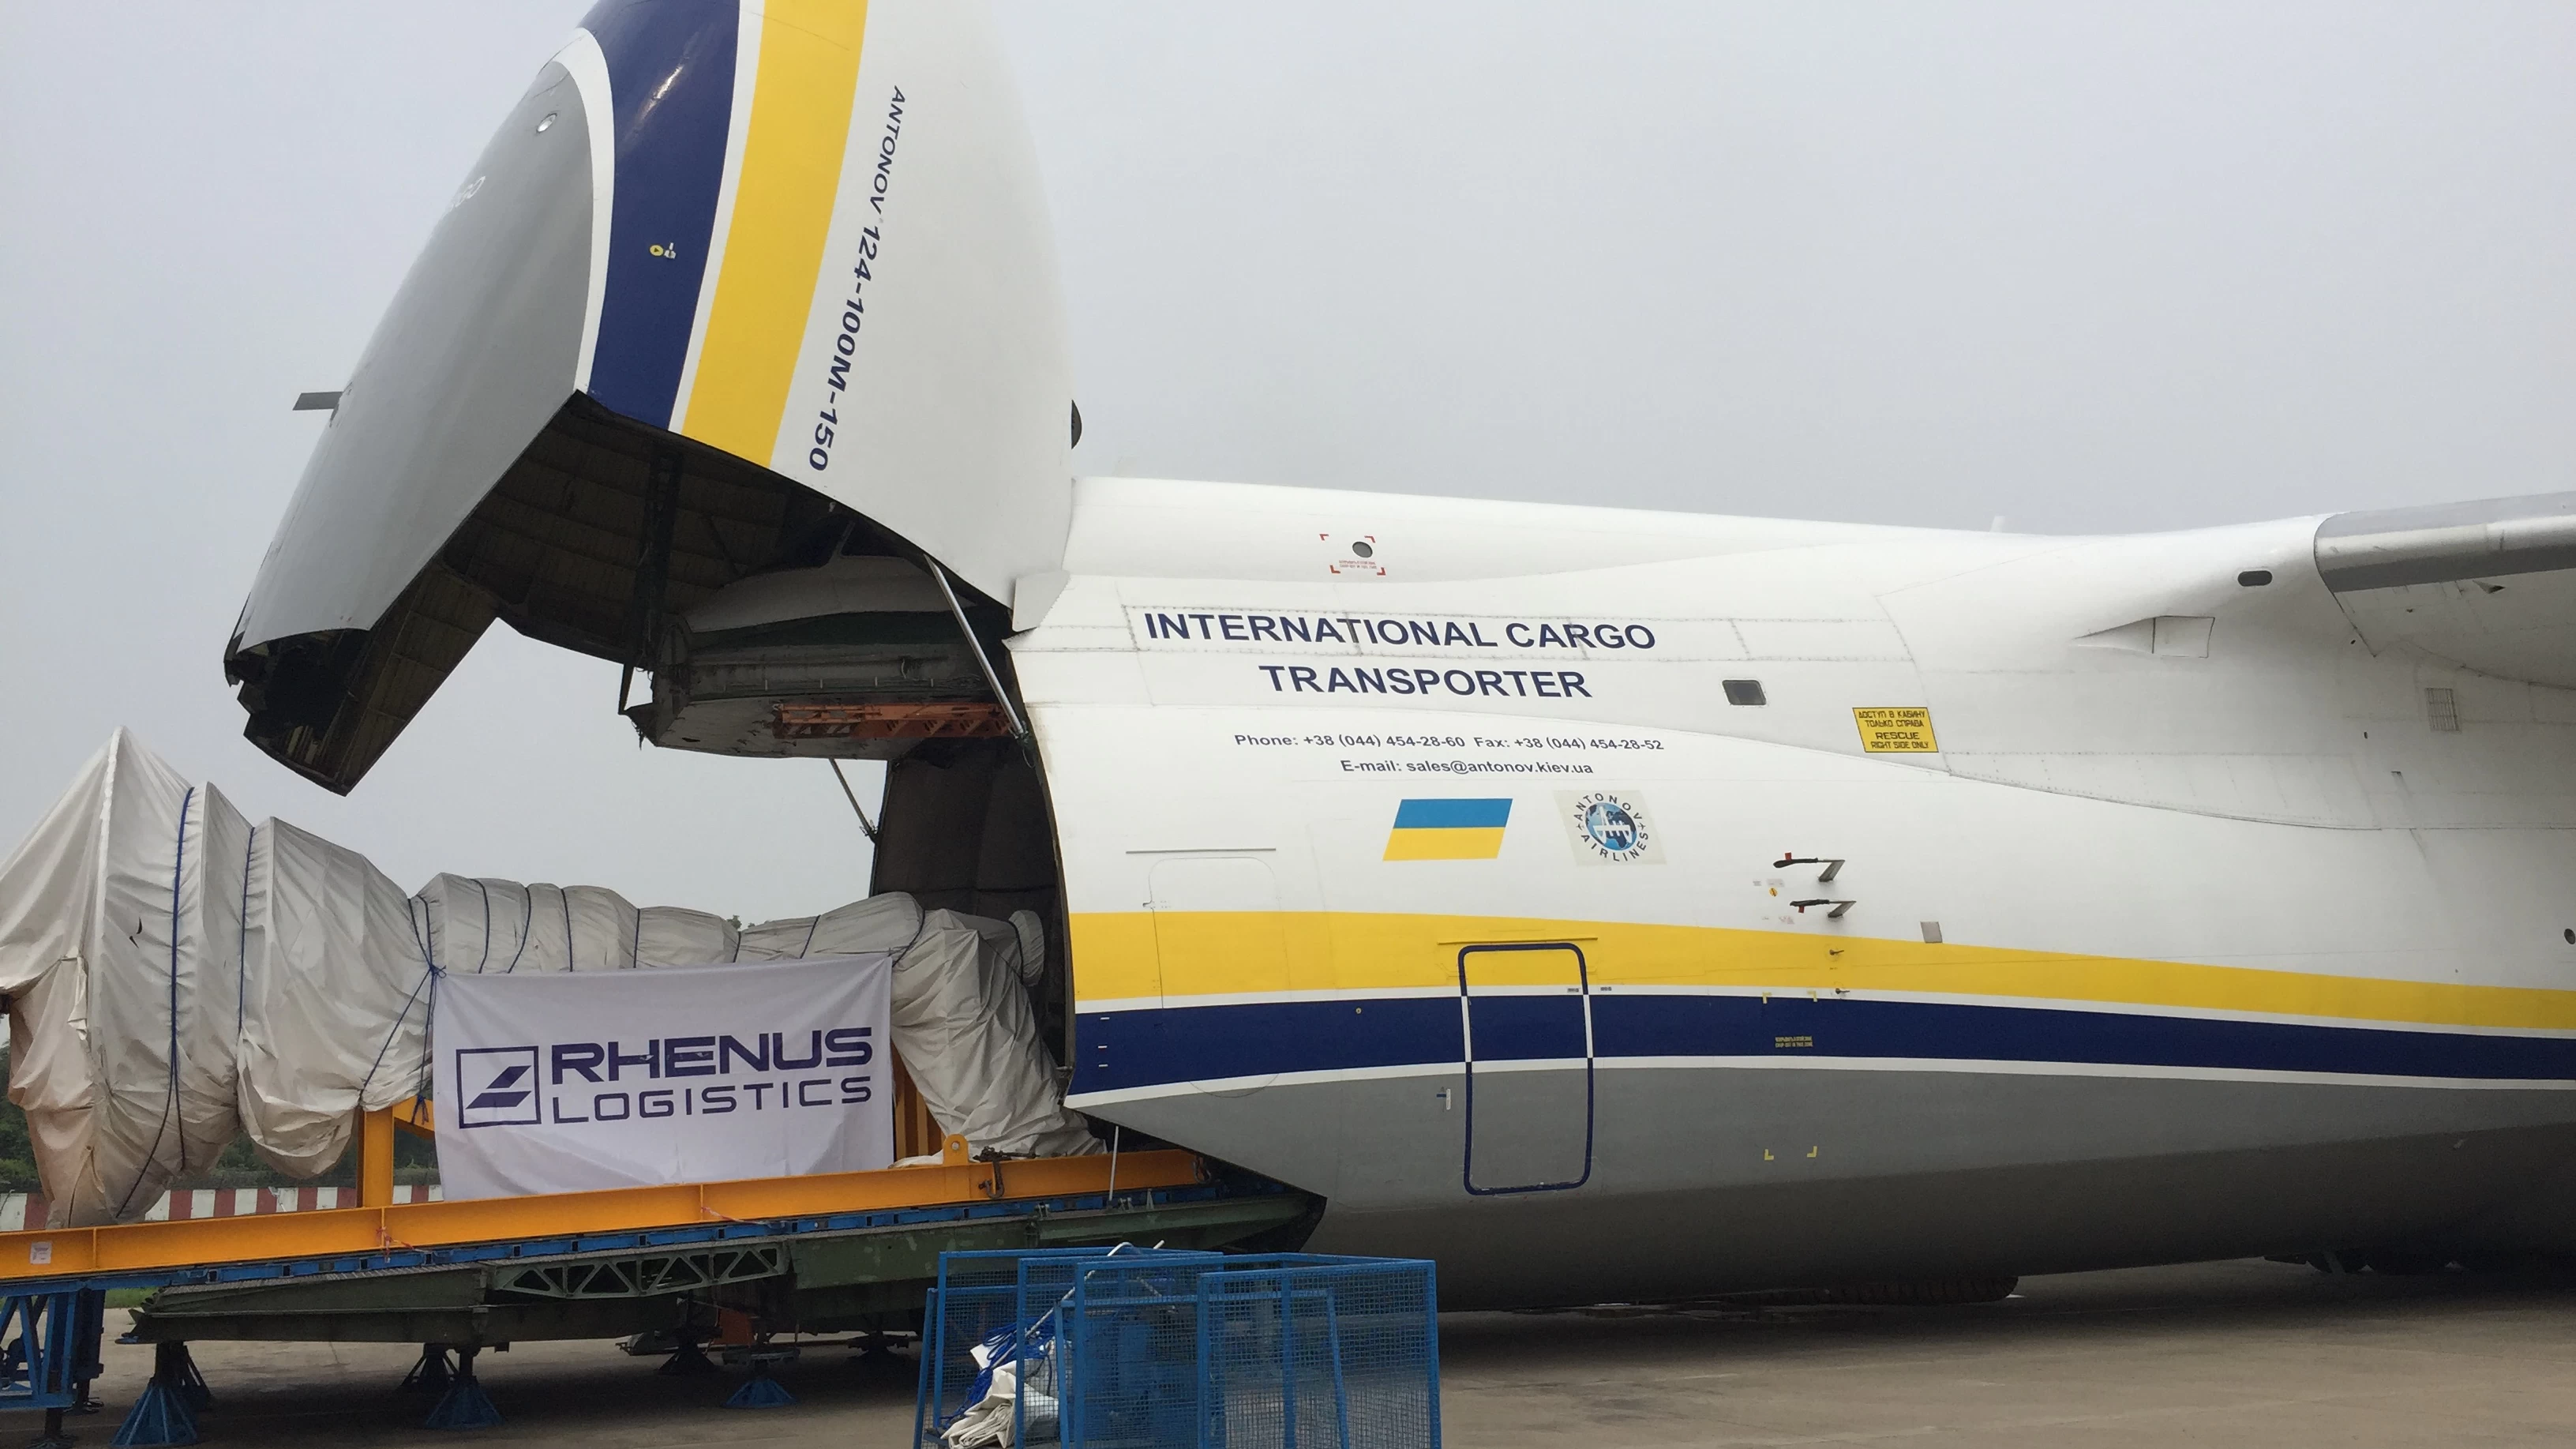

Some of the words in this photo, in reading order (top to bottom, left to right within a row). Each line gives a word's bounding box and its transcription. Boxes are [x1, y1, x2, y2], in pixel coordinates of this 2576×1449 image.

[869, 85, 906, 215] ANTONOV
[809, 226, 881, 471] 124-100M-150
[1144, 613, 1498, 648] INTERNATIONAL
[1505, 623, 1656, 650] CARGO
[1258, 665, 1593, 698] TRANSPORTER
[1234, 734, 1299, 746] Phone:
[1303, 735, 1335, 746] +38
[1338, 734, 1382, 748] (044)
[1385, 735, 1466, 748] 454-28-60
[1473, 737, 1510, 748] Fax:
[1514, 738, 1543, 749] +38
[1546, 737, 1587, 750] (044)
[1590, 738, 1665, 750] 454-28-52
[1875, 731, 1920, 740] RESCUE
[1340, 760, 1402, 772] E-mail:
[1406, 760, 1594, 775] sales@antonov.kiev.ua
[1573, 793, 1643, 821] ANTONOV
[1580, 831, 1649, 862] AIRLINES
[551, 1027, 872, 1085] RHENUS
[553, 1075, 872, 1124] LOGISTICS
